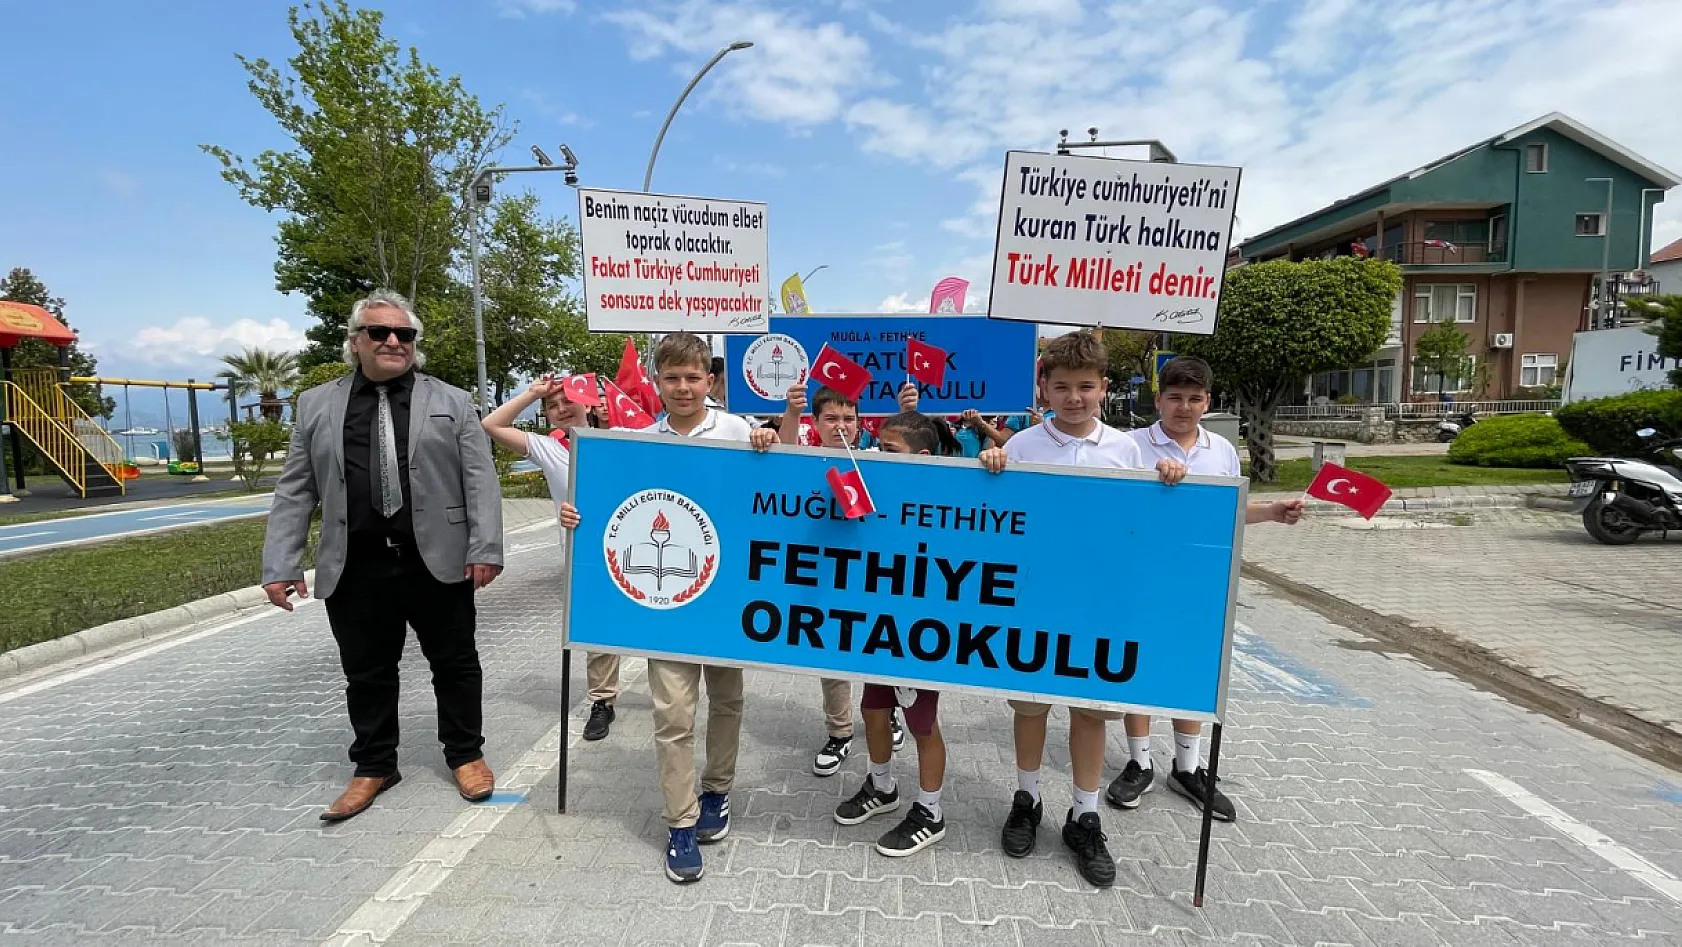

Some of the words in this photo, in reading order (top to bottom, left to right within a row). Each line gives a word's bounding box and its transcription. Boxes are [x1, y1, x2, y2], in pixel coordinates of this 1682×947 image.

[1020, 166, 1087, 206] Türkiye
[1093, 172, 1229, 213] cumhuriyeti'ni
[585, 196, 629, 220] Benim
[633, 201, 668, 228] naçiz
[673, 203, 729, 227] vücudum
[732, 206, 763, 229] elbet
[1014, 207, 1077, 241] kuran
[1085, 213, 1132, 245] Türk
[1137, 216, 1221, 251] halkına
[626, 229, 671, 255] toprak
[675, 231, 733, 254] olacaktır.
[591, 256, 631, 279] Fakat
[634, 258, 683, 285] Türkiye
[687, 260, 759, 287] Cumhuriyeti
[1007, 252, 1060, 287] Türk
[1065, 257, 1143, 294] Milleti
[1148, 261, 1217, 299] denir.
[600, 293, 654, 310] sonsuza
[658, 290, 682, 311] dek
[685, 292, 762, 317] yaşayacaktır
[616, 498, 639, 521] MİLLİ
[640, 491, 675, 503] EĞİTİM
[676, 497, 713, 545] BAKANLIĞI
[753, 490, 865, 523] MUĞL
[900, 502, 1027, 536] FETHİYE
[747, 540, 1018, 607] FETHİYE
[648, 595, 670, 606] 1920
[741, 600, 1140, 683] ORTAOKULU
